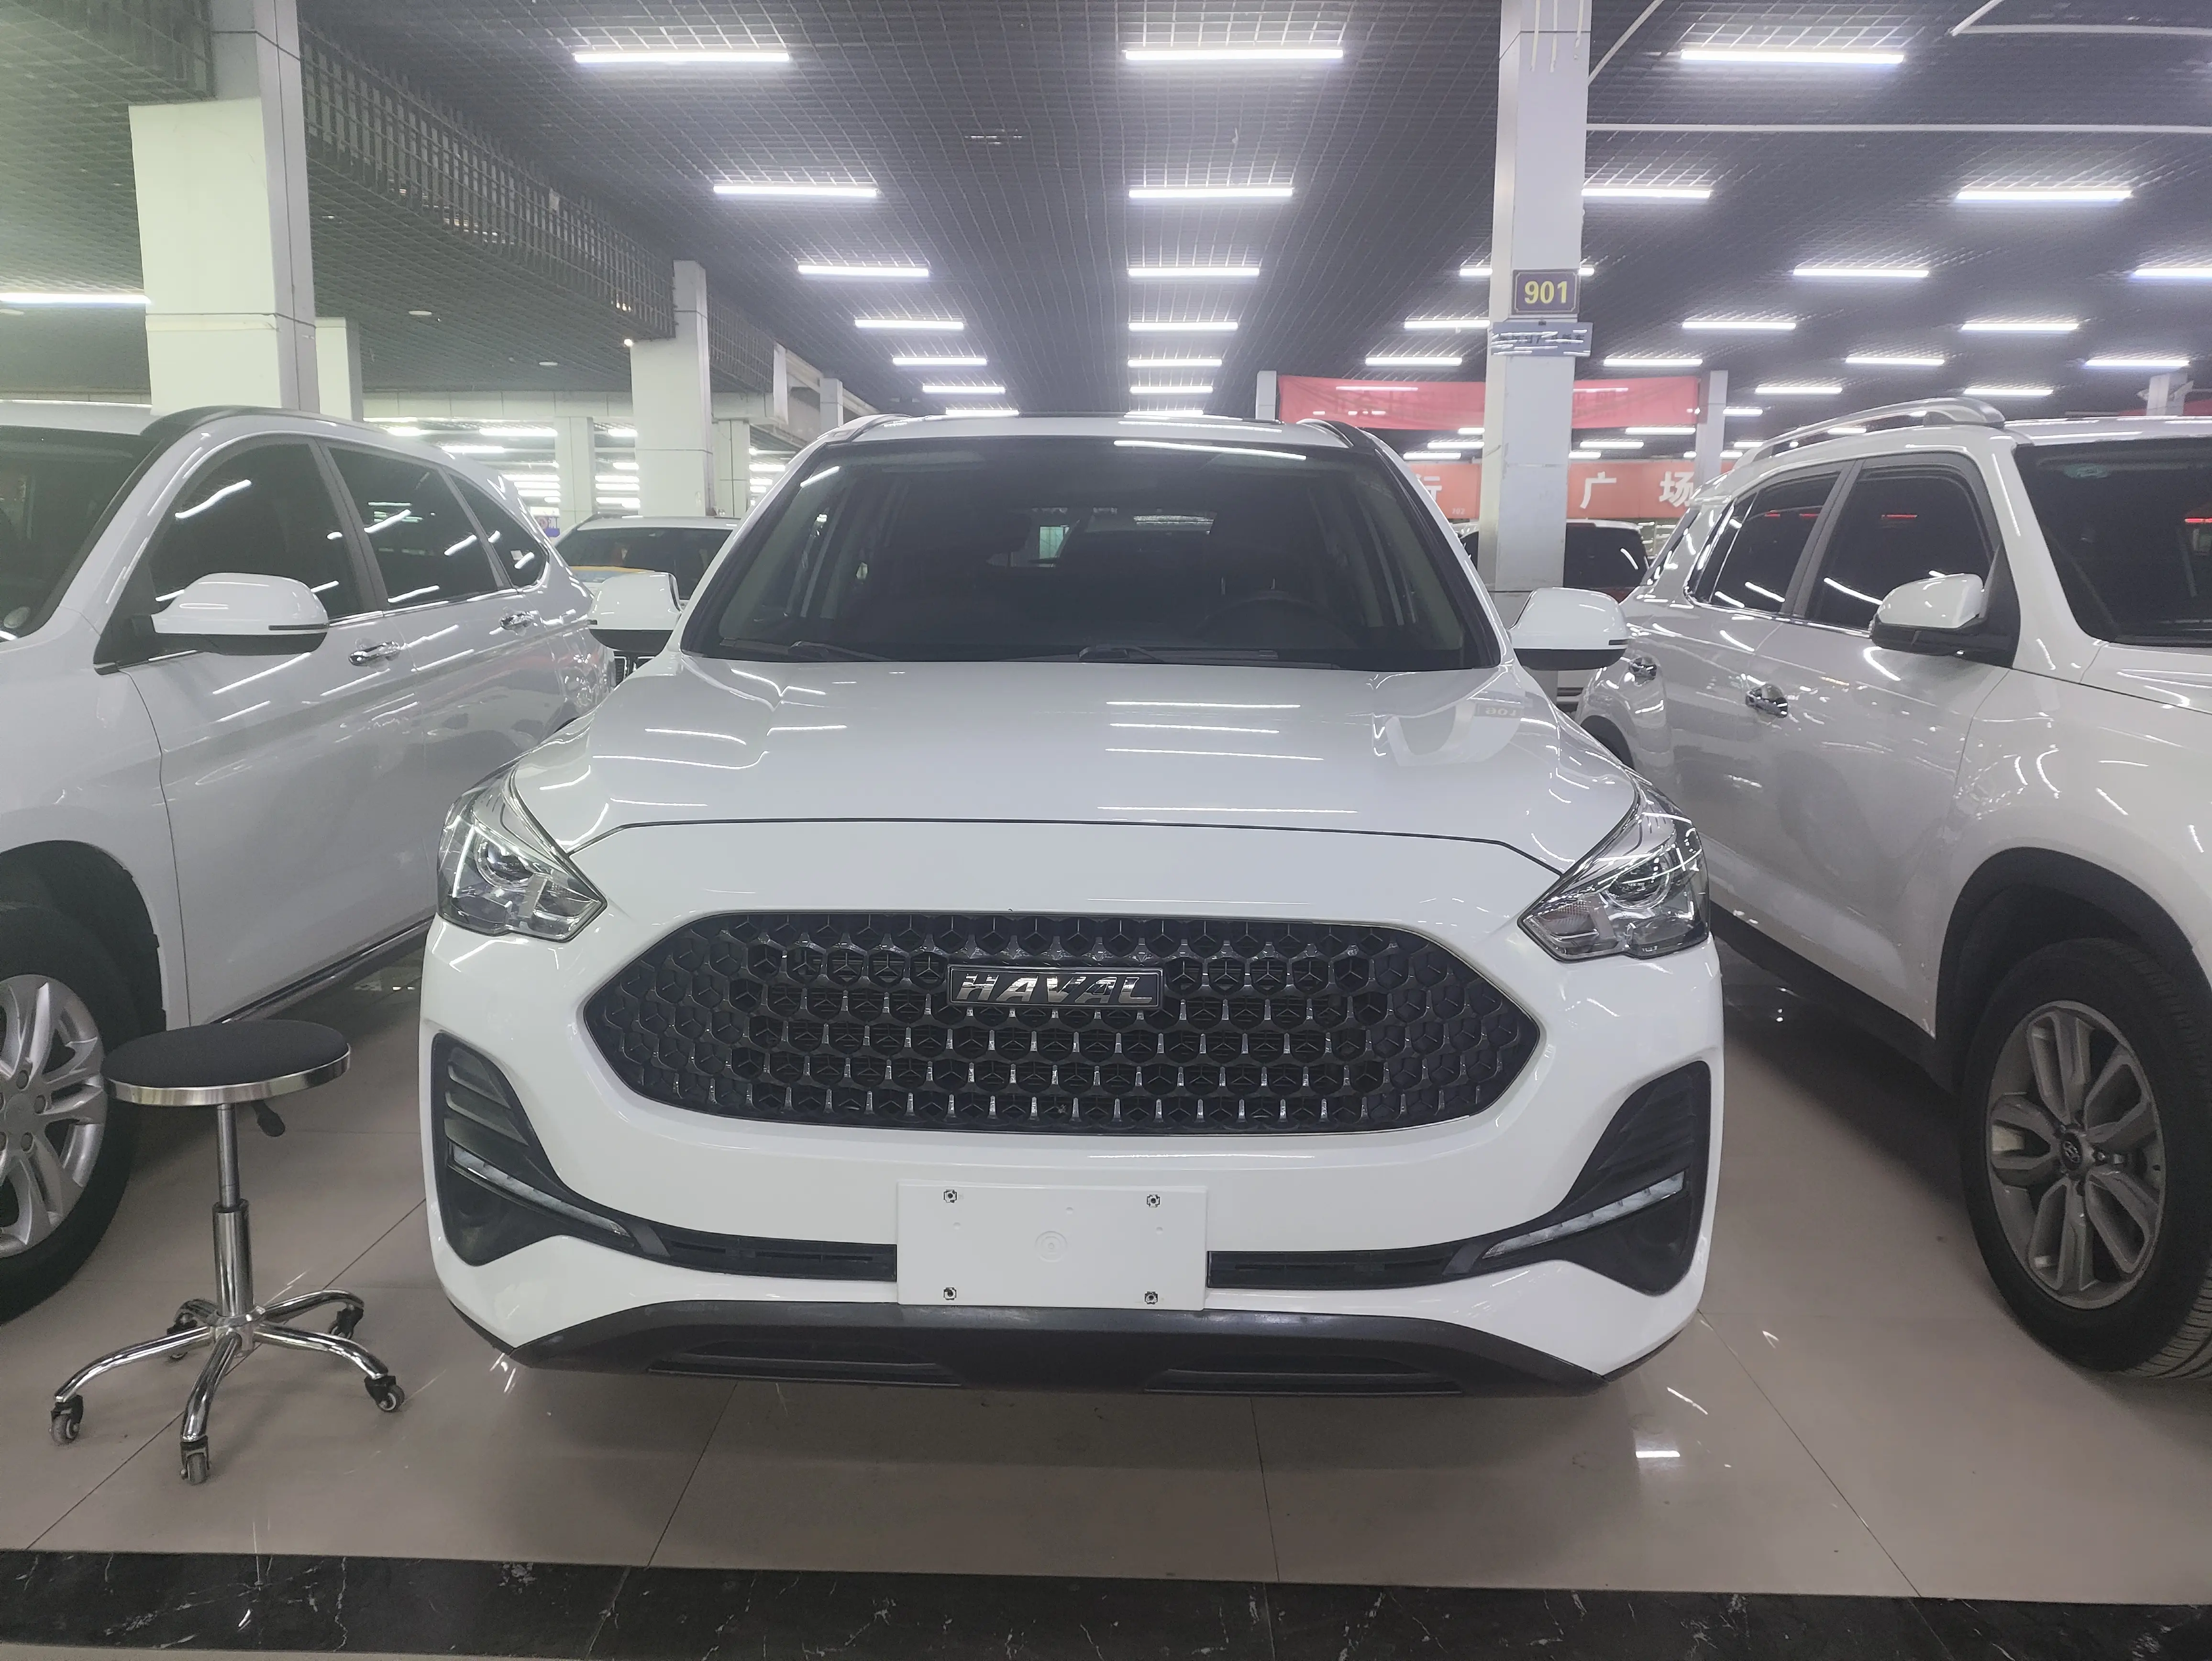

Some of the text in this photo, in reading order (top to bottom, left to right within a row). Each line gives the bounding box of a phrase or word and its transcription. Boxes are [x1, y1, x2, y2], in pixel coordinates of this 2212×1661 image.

[1524, 280, 1568, 304] 901
[1579, 471, 1695, 509] 广场
[956, 973, 1153, 1004] HAVAL
